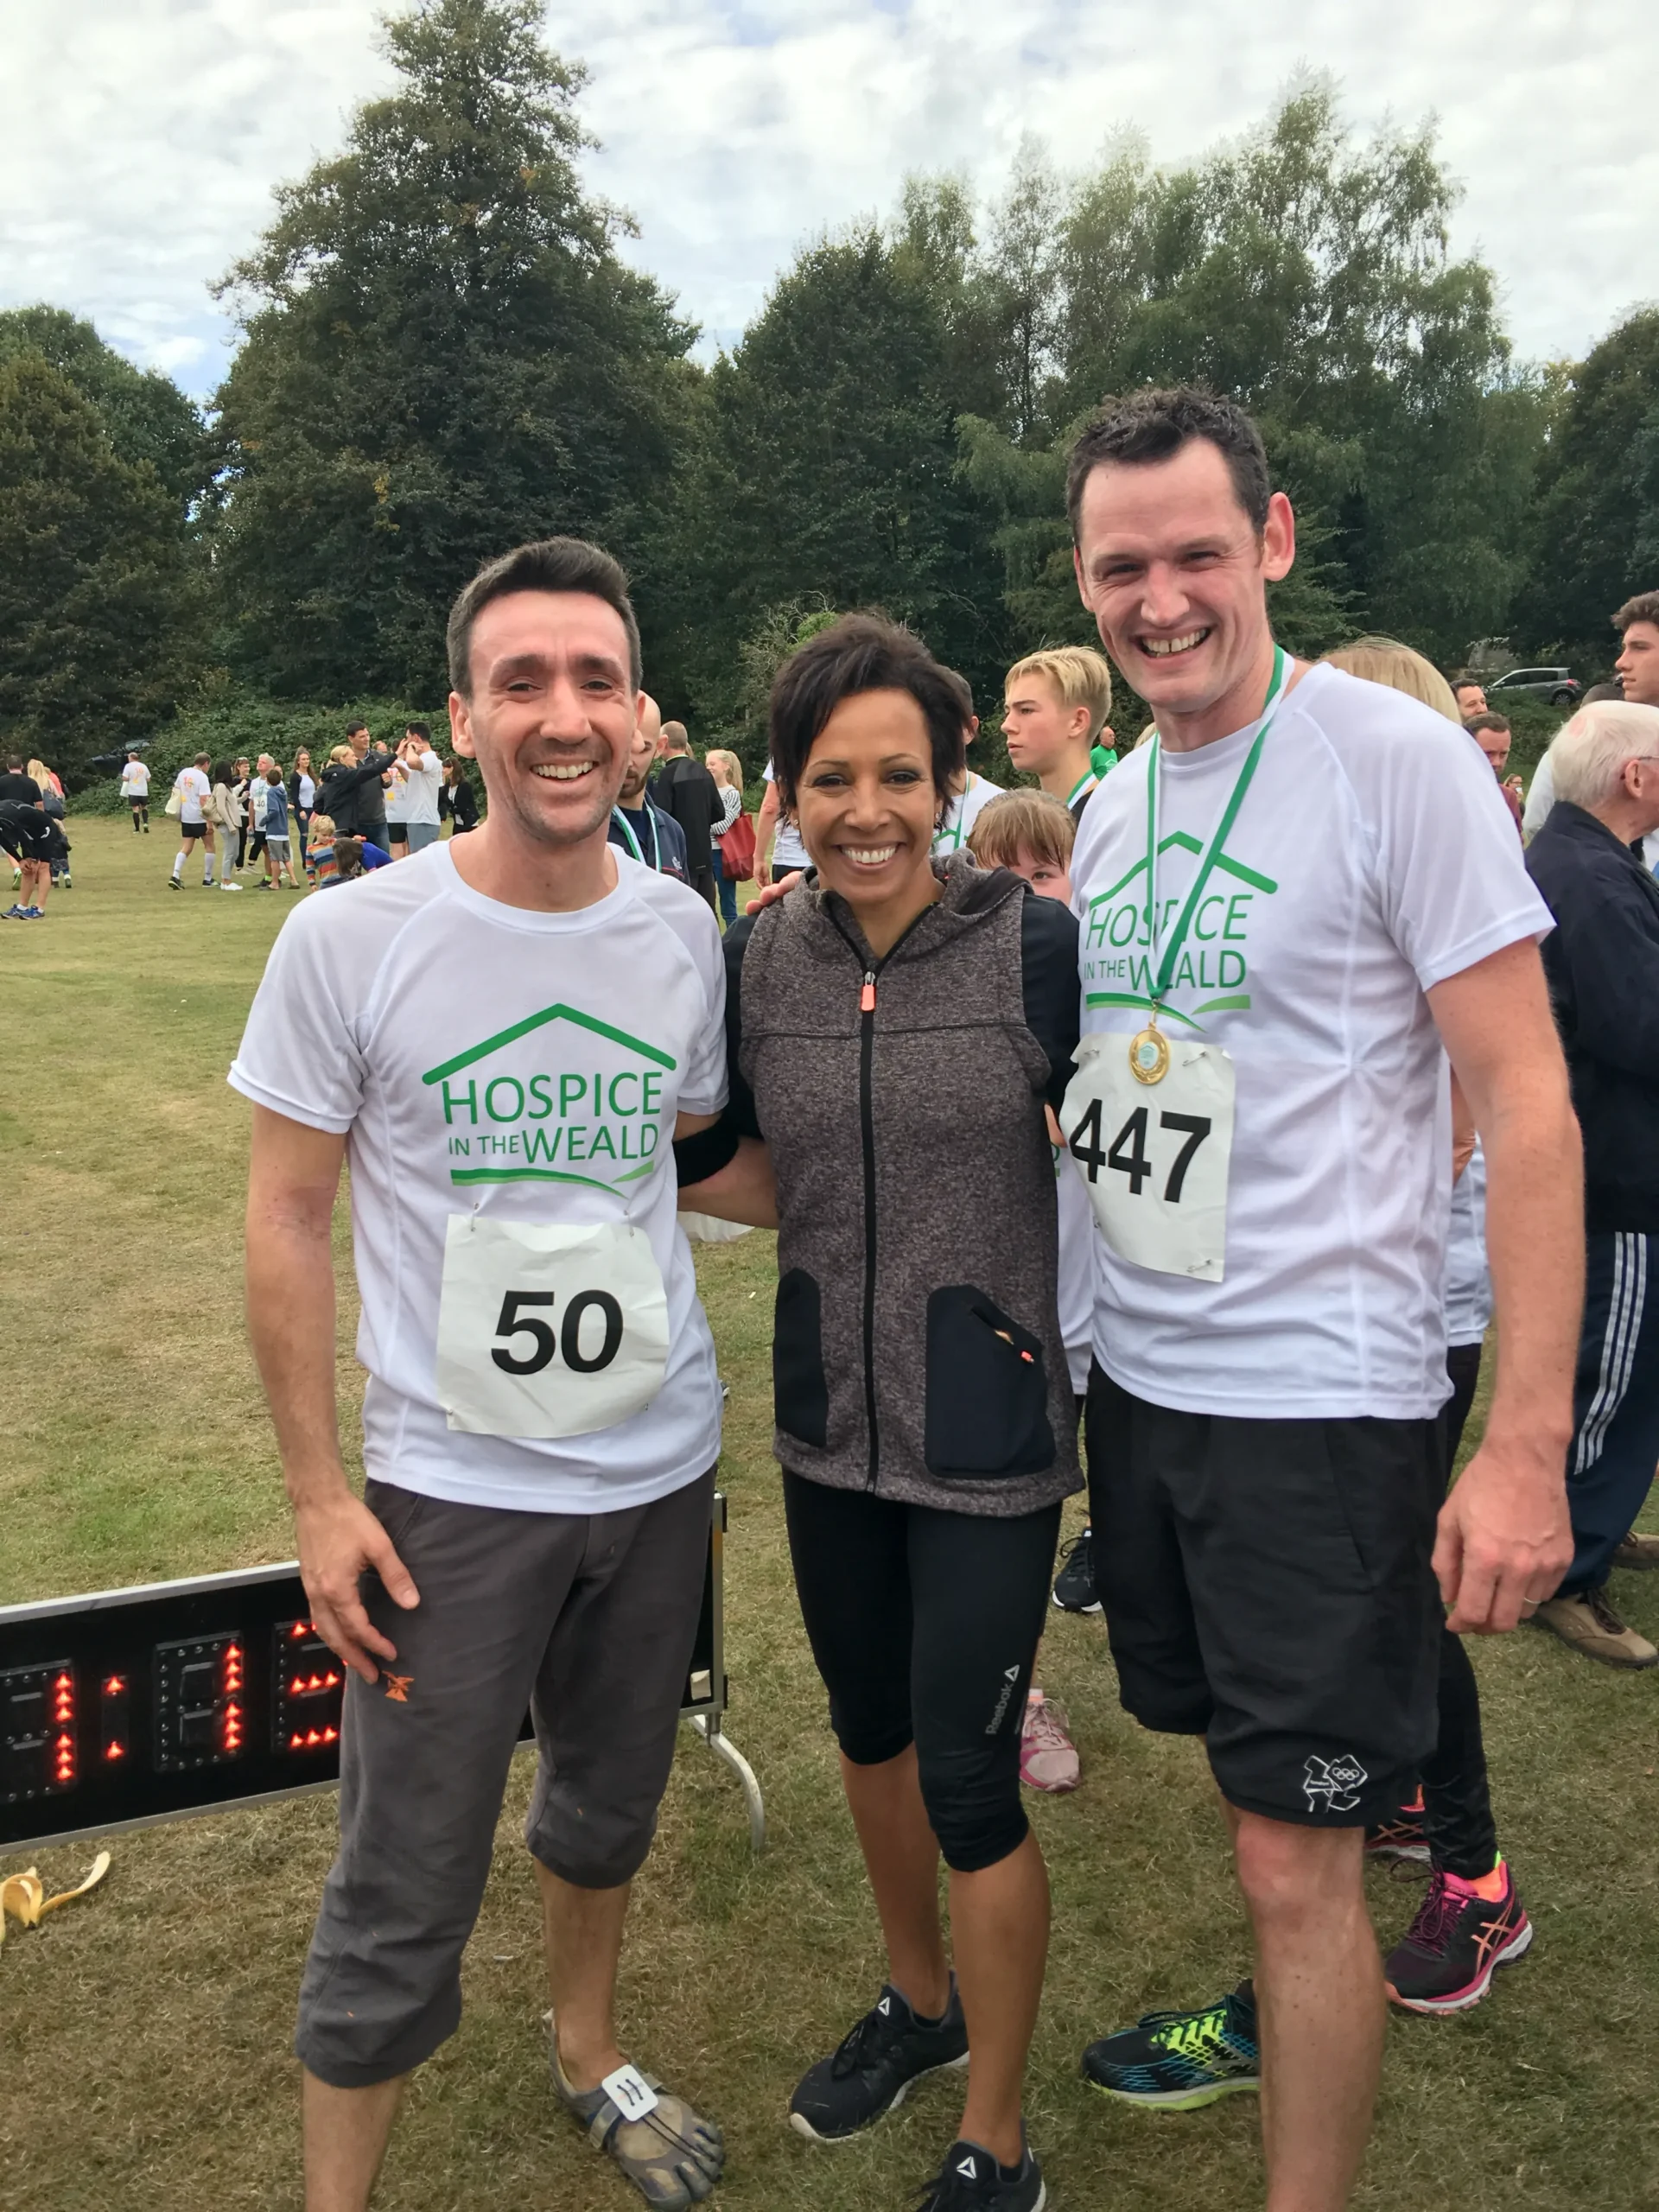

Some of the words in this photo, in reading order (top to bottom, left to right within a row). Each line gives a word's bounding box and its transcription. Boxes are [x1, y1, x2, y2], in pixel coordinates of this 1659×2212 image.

[1084, 961, 1095, 980] IN
[1098, 959, 1126, 979] THE
[1128, 950, 1246, 991] WALD
[442, 1071, 663, 1125] HOSPICE
[448, 1137, 470, 1156] IN
[477, 1135, 519, 1155] THE
[521, 1122, 659, 1165] WEALD
[1069, 1098, 1211, 1204] 447
[490, 1288, 624, 1376] 50
[985, 1683, 1014, 1734] Reebok
